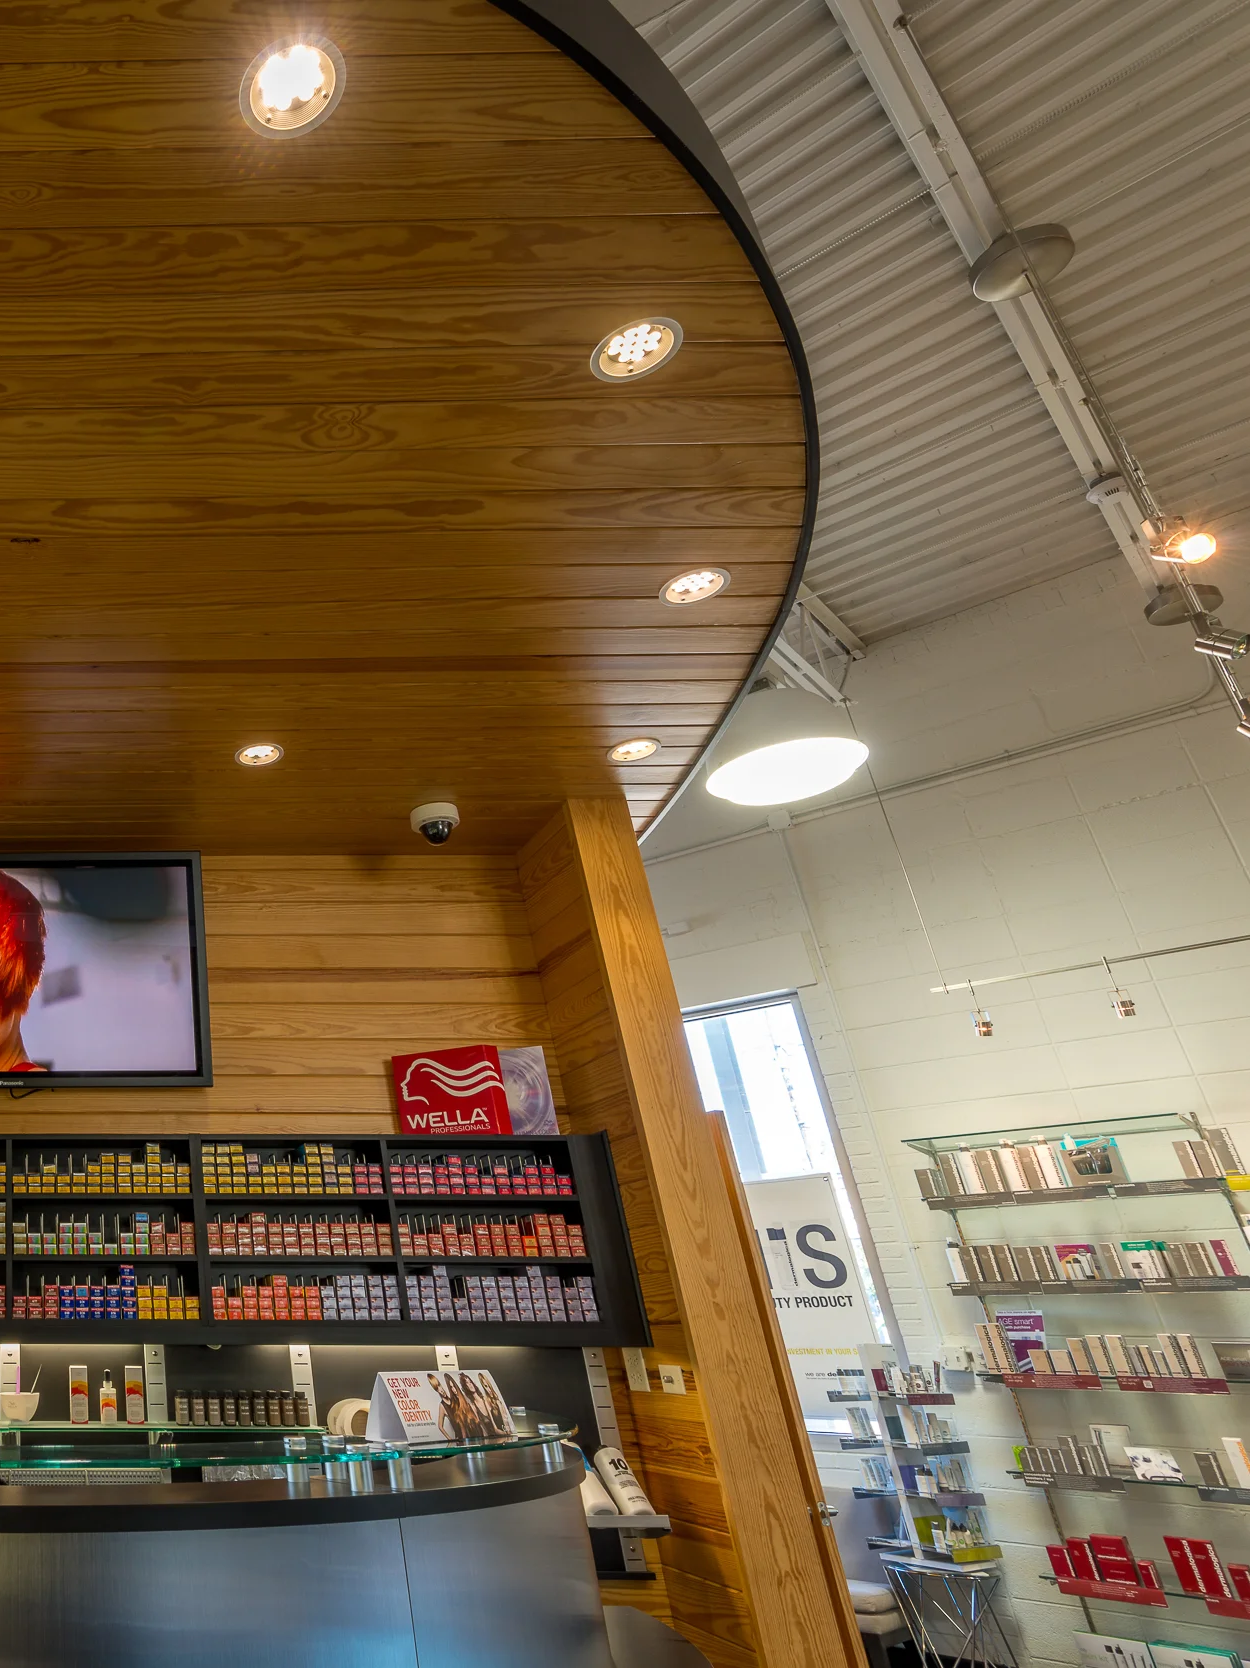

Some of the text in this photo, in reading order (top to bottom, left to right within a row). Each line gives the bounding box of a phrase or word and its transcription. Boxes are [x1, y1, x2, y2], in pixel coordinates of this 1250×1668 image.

[407, 1108, 489, 1129] WELLA
[431, 1122, 491, 1134] PROFESSIONALS
[1011, 1151, 1027, 1190] dermalogica
[1028, 1146, 1048, 1189] dermalogica
[1047, 1147, 1065, 1186] dermalogica
[1220, 1128, 1247, 1176] dermalogica
[948, 1154, 965, 1195] dermalogica
[986, 1151, 1005, 1193] dermalogica
[795, 1295, 853, 1308] PRODUCT
[982, 1325, 1002, 1373] dermalogica
[995, 1324, 1014, 1373] dermalogica
[1167, 1335, 1188, 1377] dermalogica
[1186, 1335, 1207, 1378] dermalogica
[386, 1377, 421, 1389] GET YOUR
[392, 1389, 410, 1399] NEW
[397, 1400, 421, 1411] COLOR
[402, 1410, 433, 1422] IDENTITY
[608, 1458, 629, 1471] 10
[1083, 1543, 1100, 1581] dermalogica
[1181, 1540, 1207, 1593] dermalogica
[1205, 1543, 1232, 1598] dermalogica
